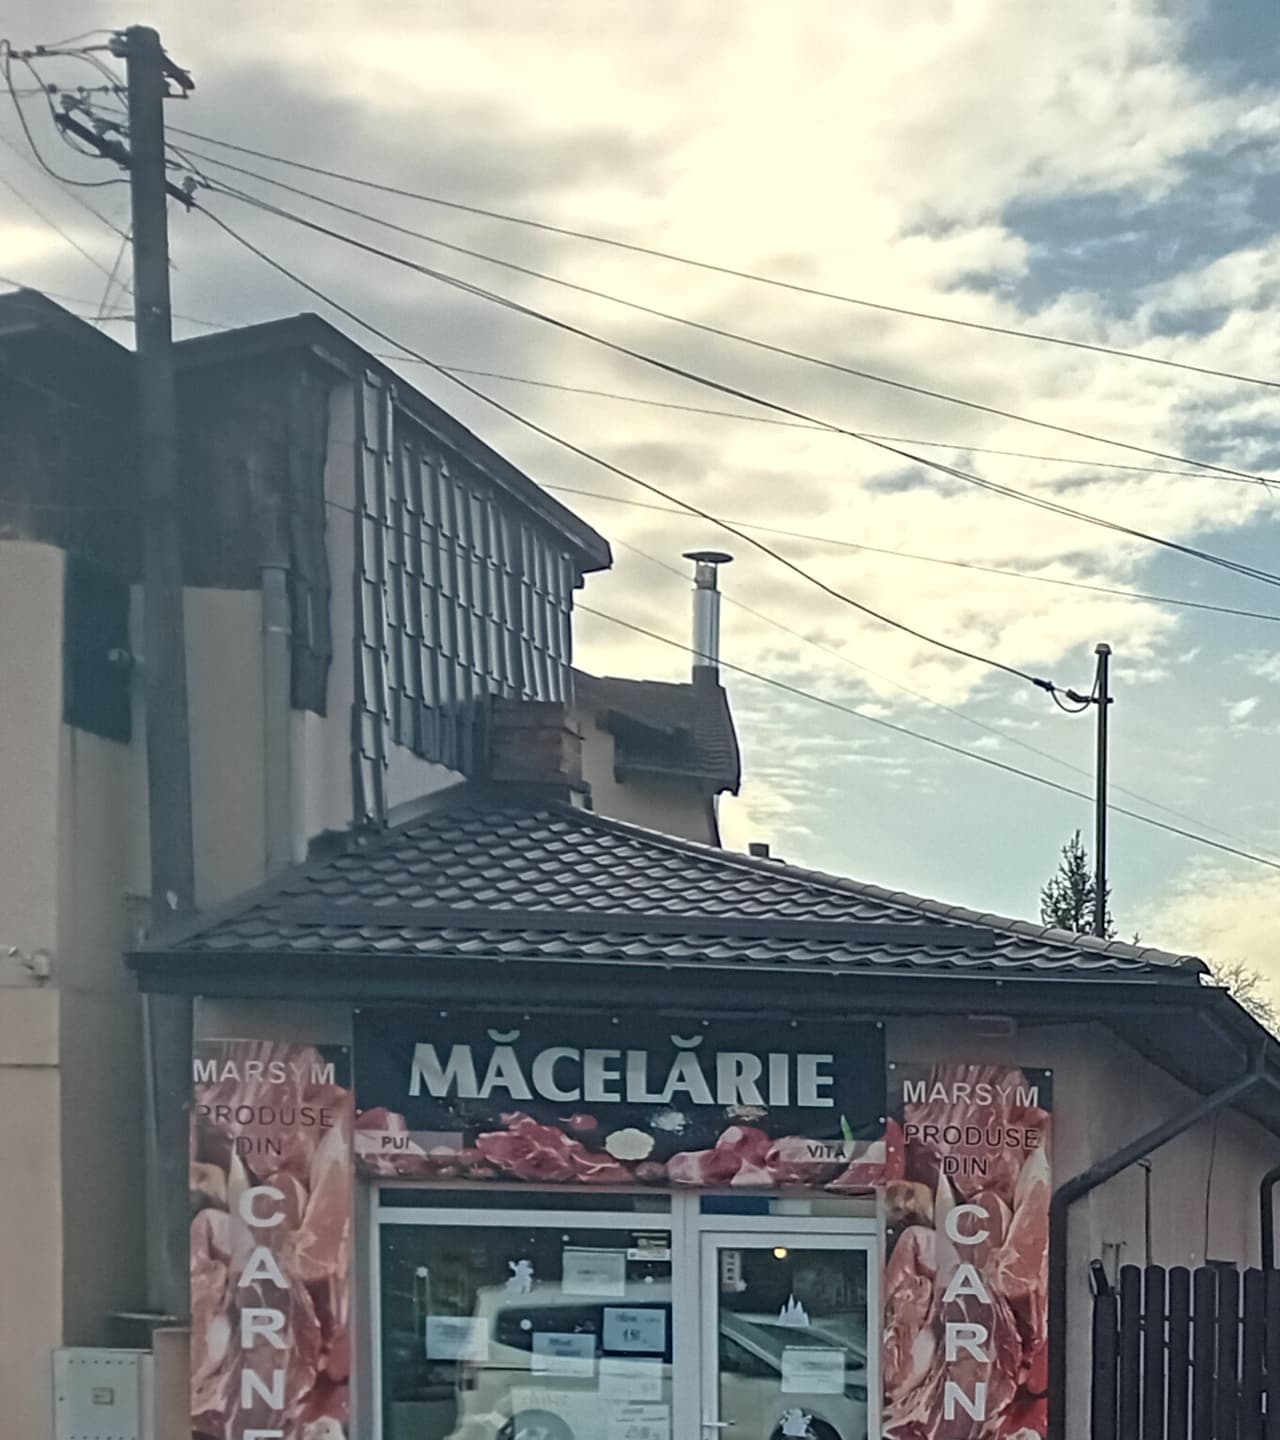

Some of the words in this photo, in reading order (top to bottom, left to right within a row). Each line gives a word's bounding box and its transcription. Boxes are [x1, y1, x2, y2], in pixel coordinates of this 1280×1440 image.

[193, 1059, 335, 1085] MARSYM
[408, 1029, 835, 1107] MĂCELĂRIE
[903, 1080, 1038, 1107] MARSYM
[199, 1104, 334, 1128] PRODUSE
[236, 1136, 282, 1156] DIN
[381, 1136, 410, 1149] PUI
[905, 1124, 1039, 1149] PRODUSE
[943, 1155, 988, 1176] DIN
